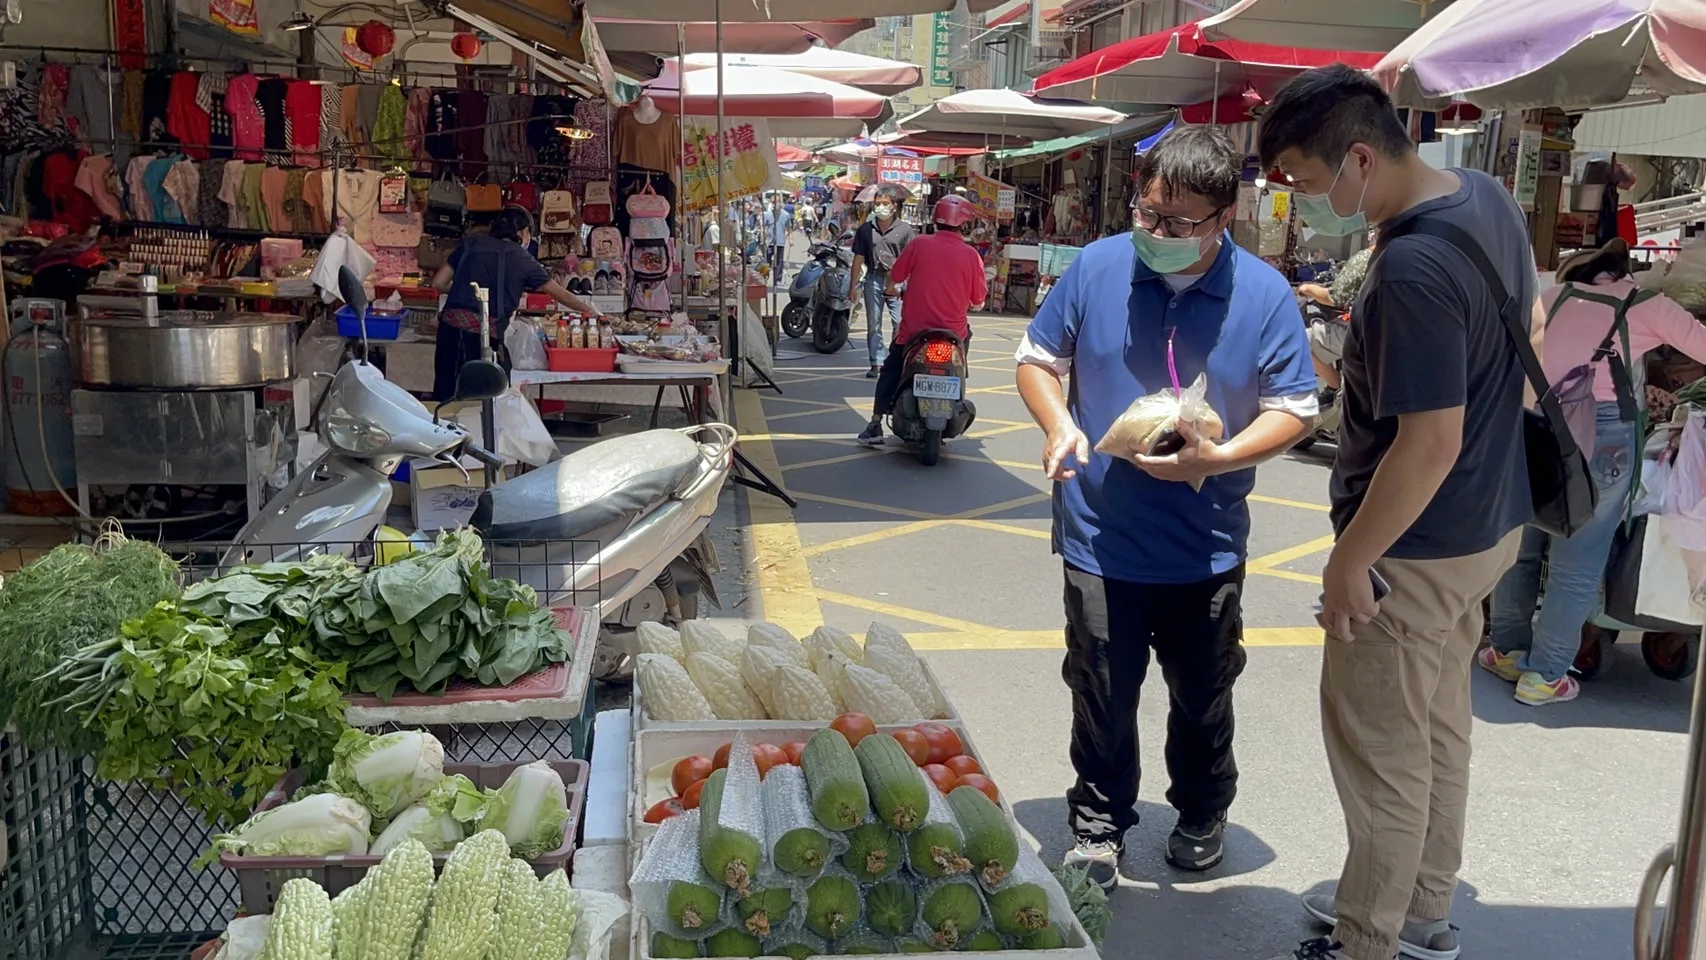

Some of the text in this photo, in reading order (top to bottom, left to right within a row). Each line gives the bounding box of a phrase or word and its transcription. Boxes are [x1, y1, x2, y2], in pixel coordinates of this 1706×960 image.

[881, 158, 920, 171] 澎湖名產
[915, 380, 958, 394] MGW-8877
